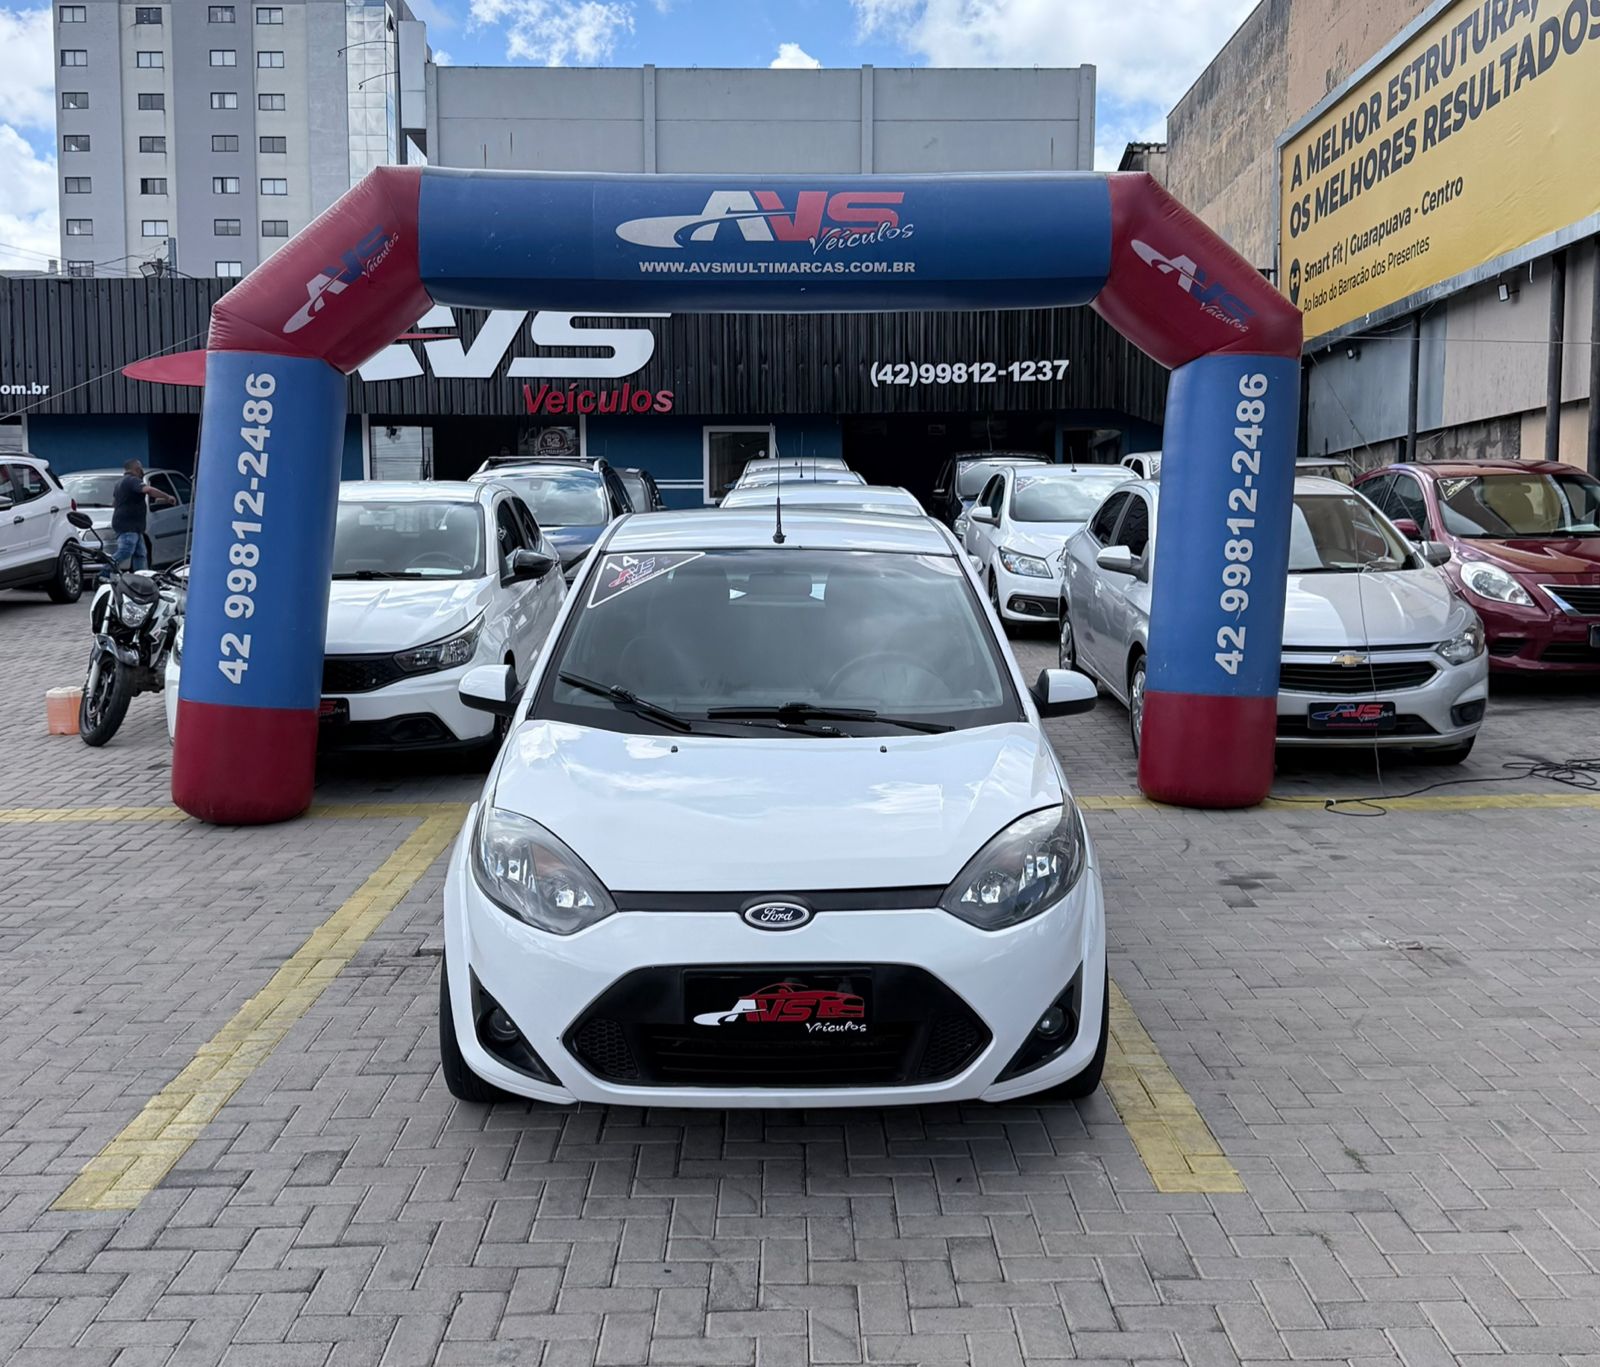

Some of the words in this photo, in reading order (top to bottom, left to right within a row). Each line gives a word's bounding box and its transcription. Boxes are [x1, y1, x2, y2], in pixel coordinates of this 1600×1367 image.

[1290, 153, 1303, 192] A
[1306, 91, 1382, 181] MELHOR
[1290, 193, 1311, 238] OS
[1314, 118, 1418, 224] MELHORES
[680, 190, 905, 243] AVS
[808, 221, 915, 255] Veículos
[1304, 251, 1331, 283] Smart
[1332, 239, 1344, 269] Fit
[1350, 207, 1412, 256] Guarapuava
[1421, 176, 1464, 216] Centro
[638, 261, 916, 274] WWW.AVSMULTIMARCAS.COM.BR
[1303, 298, 1312, 313] Ao
[1312, 290, 1328, 310] lado
[1328, 283, 1337, 301] do
[1371, 259, 1386, 279] dos
[1388, 236, 1430, 271] Presentes
[522, 383, 675, 414] Veículos
[870, 359, 1070, 388] (42)99812-1237
[223, 372, 276, 620] 99812-2486
[1220, 373, 1269, 613] 99812-2486
[606, 556, 640, 572] 14
[218, 632, 252, 685] 42
[1215, 625, 1247, 676] 42
[760, 906, 794, 922] Ford
